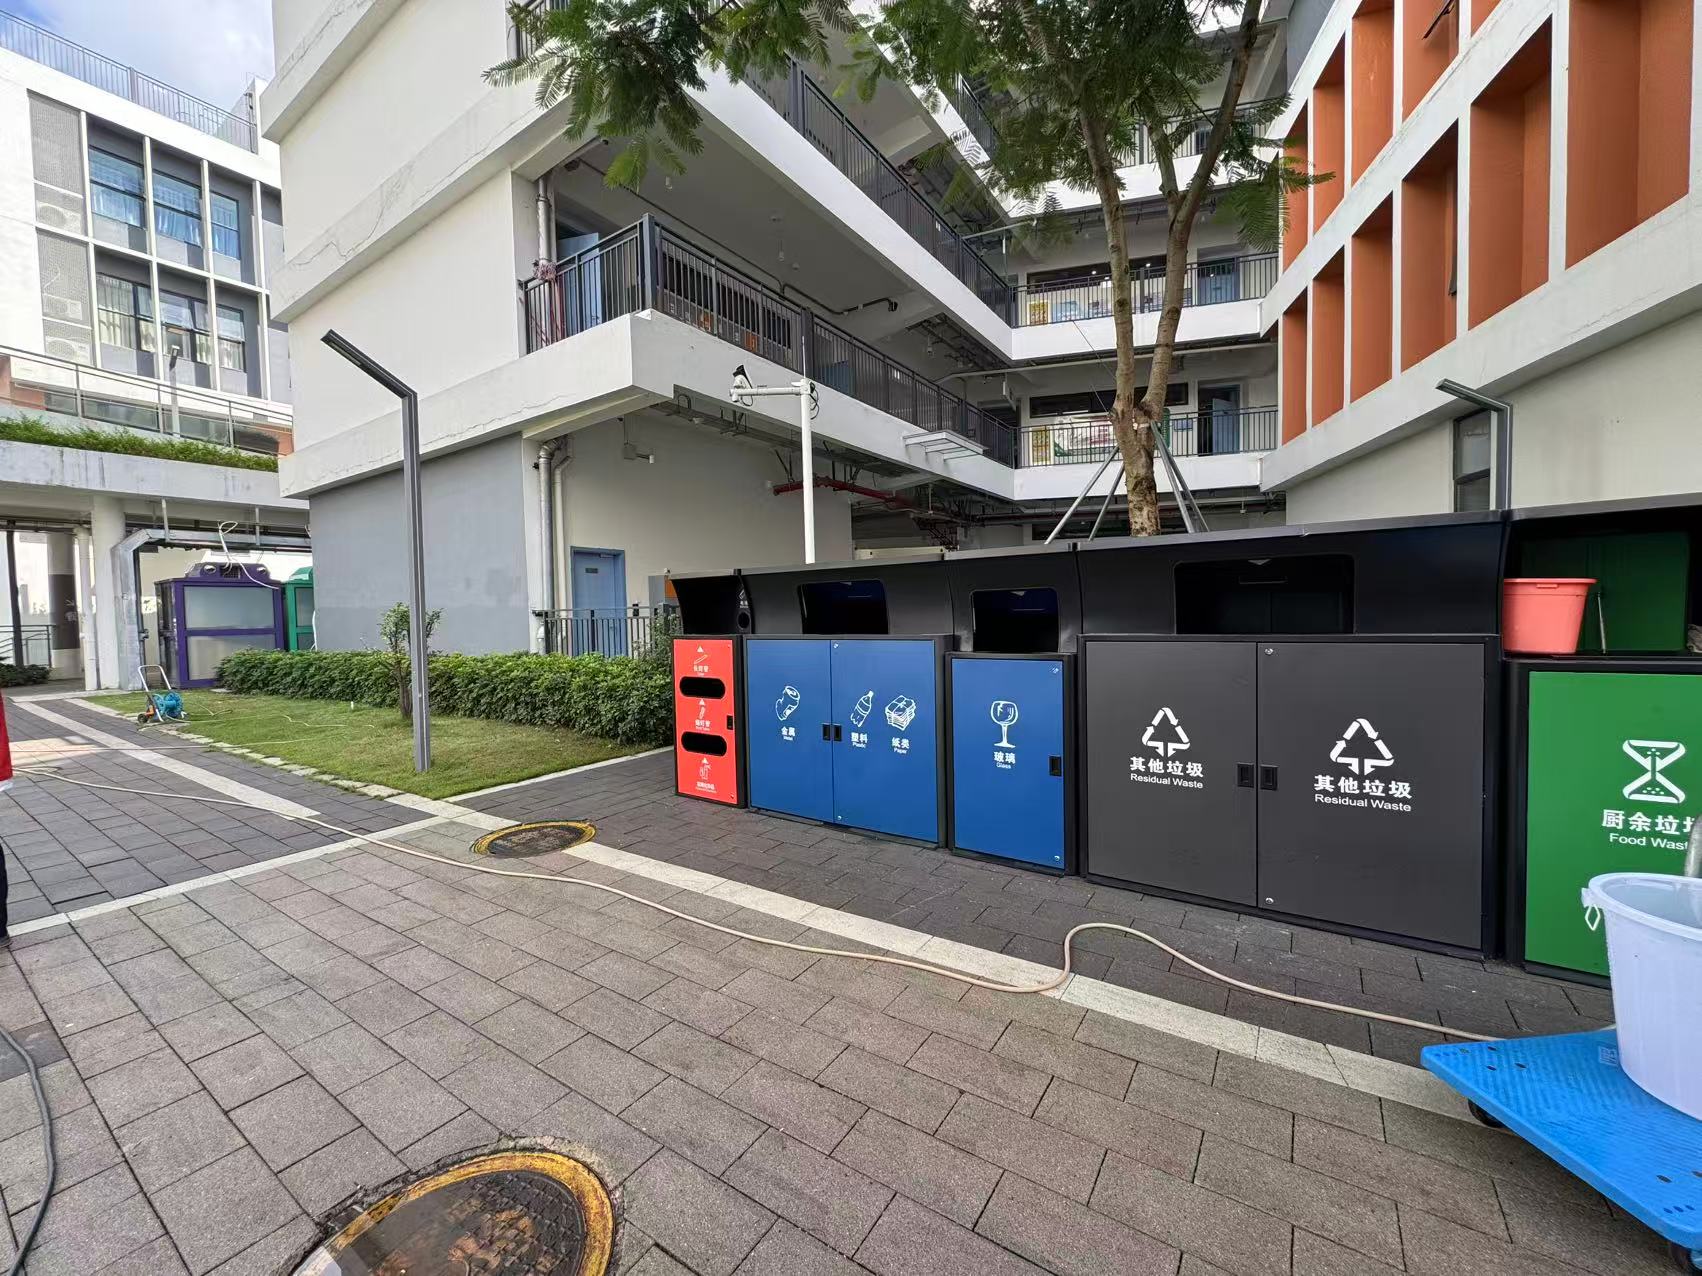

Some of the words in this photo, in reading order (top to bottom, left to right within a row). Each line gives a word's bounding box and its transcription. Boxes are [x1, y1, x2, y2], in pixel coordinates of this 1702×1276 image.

[781, 726, 795, 736] 金属
[851, 732, 868, 743] 塑料
[891, 737, 910, 749] 纸类
[993, 751, 1016, 764] 玻璃
[1129, 756, 1204, 778] 其他垃圾
[1130, 773, 1170, 785] Residual
[1172, 778, 1203, 789] Waste
[1313, 774, 1412, 799] 其他垃圾
[1314, 793, 1368, 807] Residual
[1370, 799, 1412, 812] Waste
[1609, 832, 1647, 846] Food
